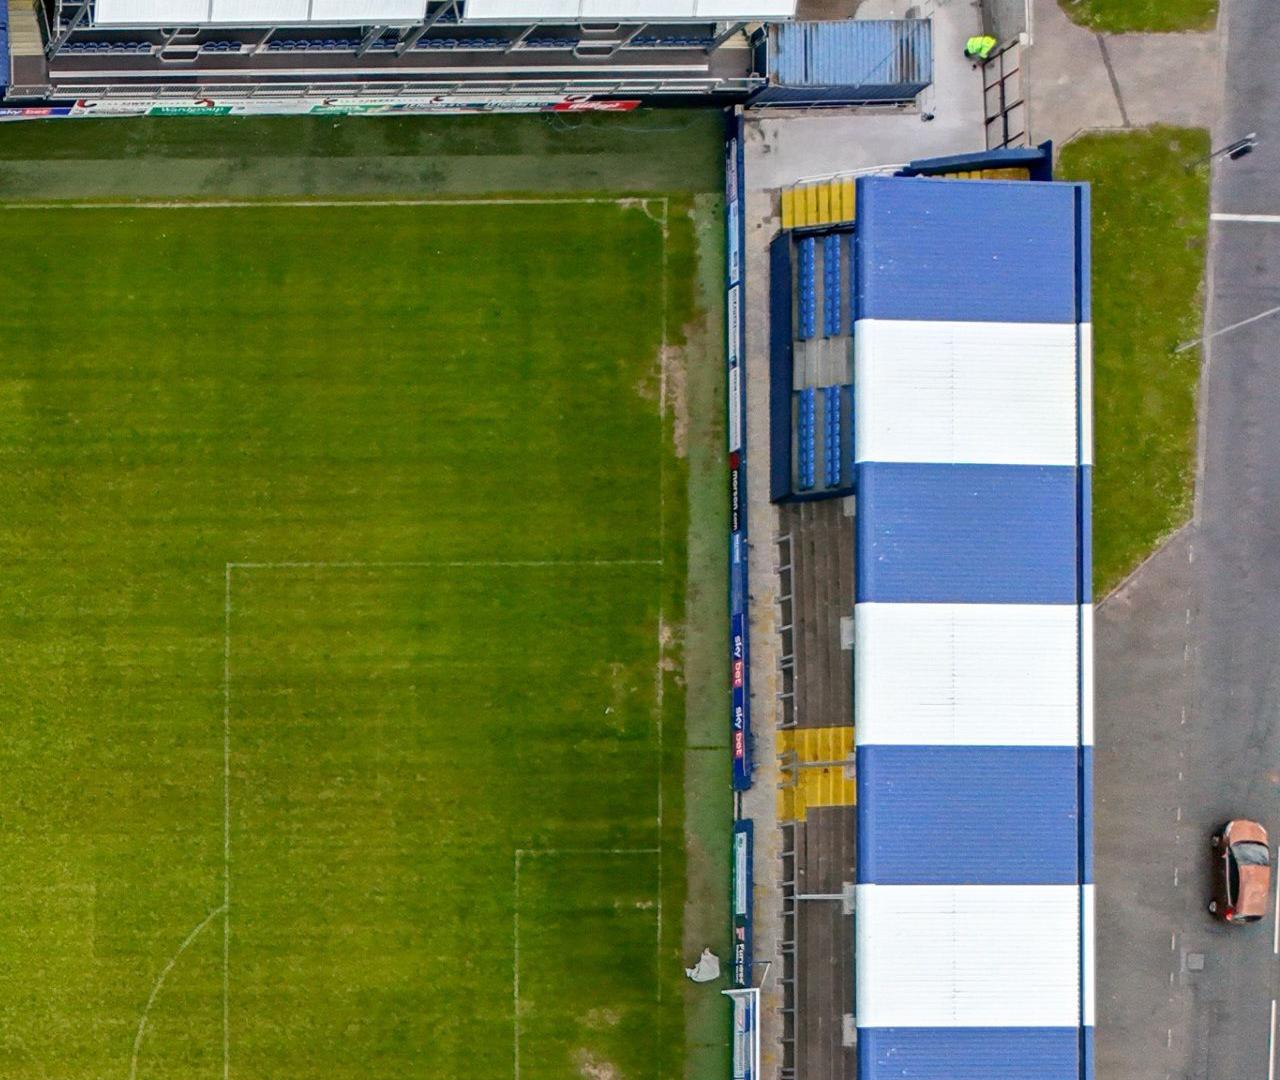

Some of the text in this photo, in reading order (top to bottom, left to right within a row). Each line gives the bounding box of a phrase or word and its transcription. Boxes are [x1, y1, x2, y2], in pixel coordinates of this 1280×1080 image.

[734, 634, 742, 685] sky bet
[734, 706, 743, 756] sky bet
